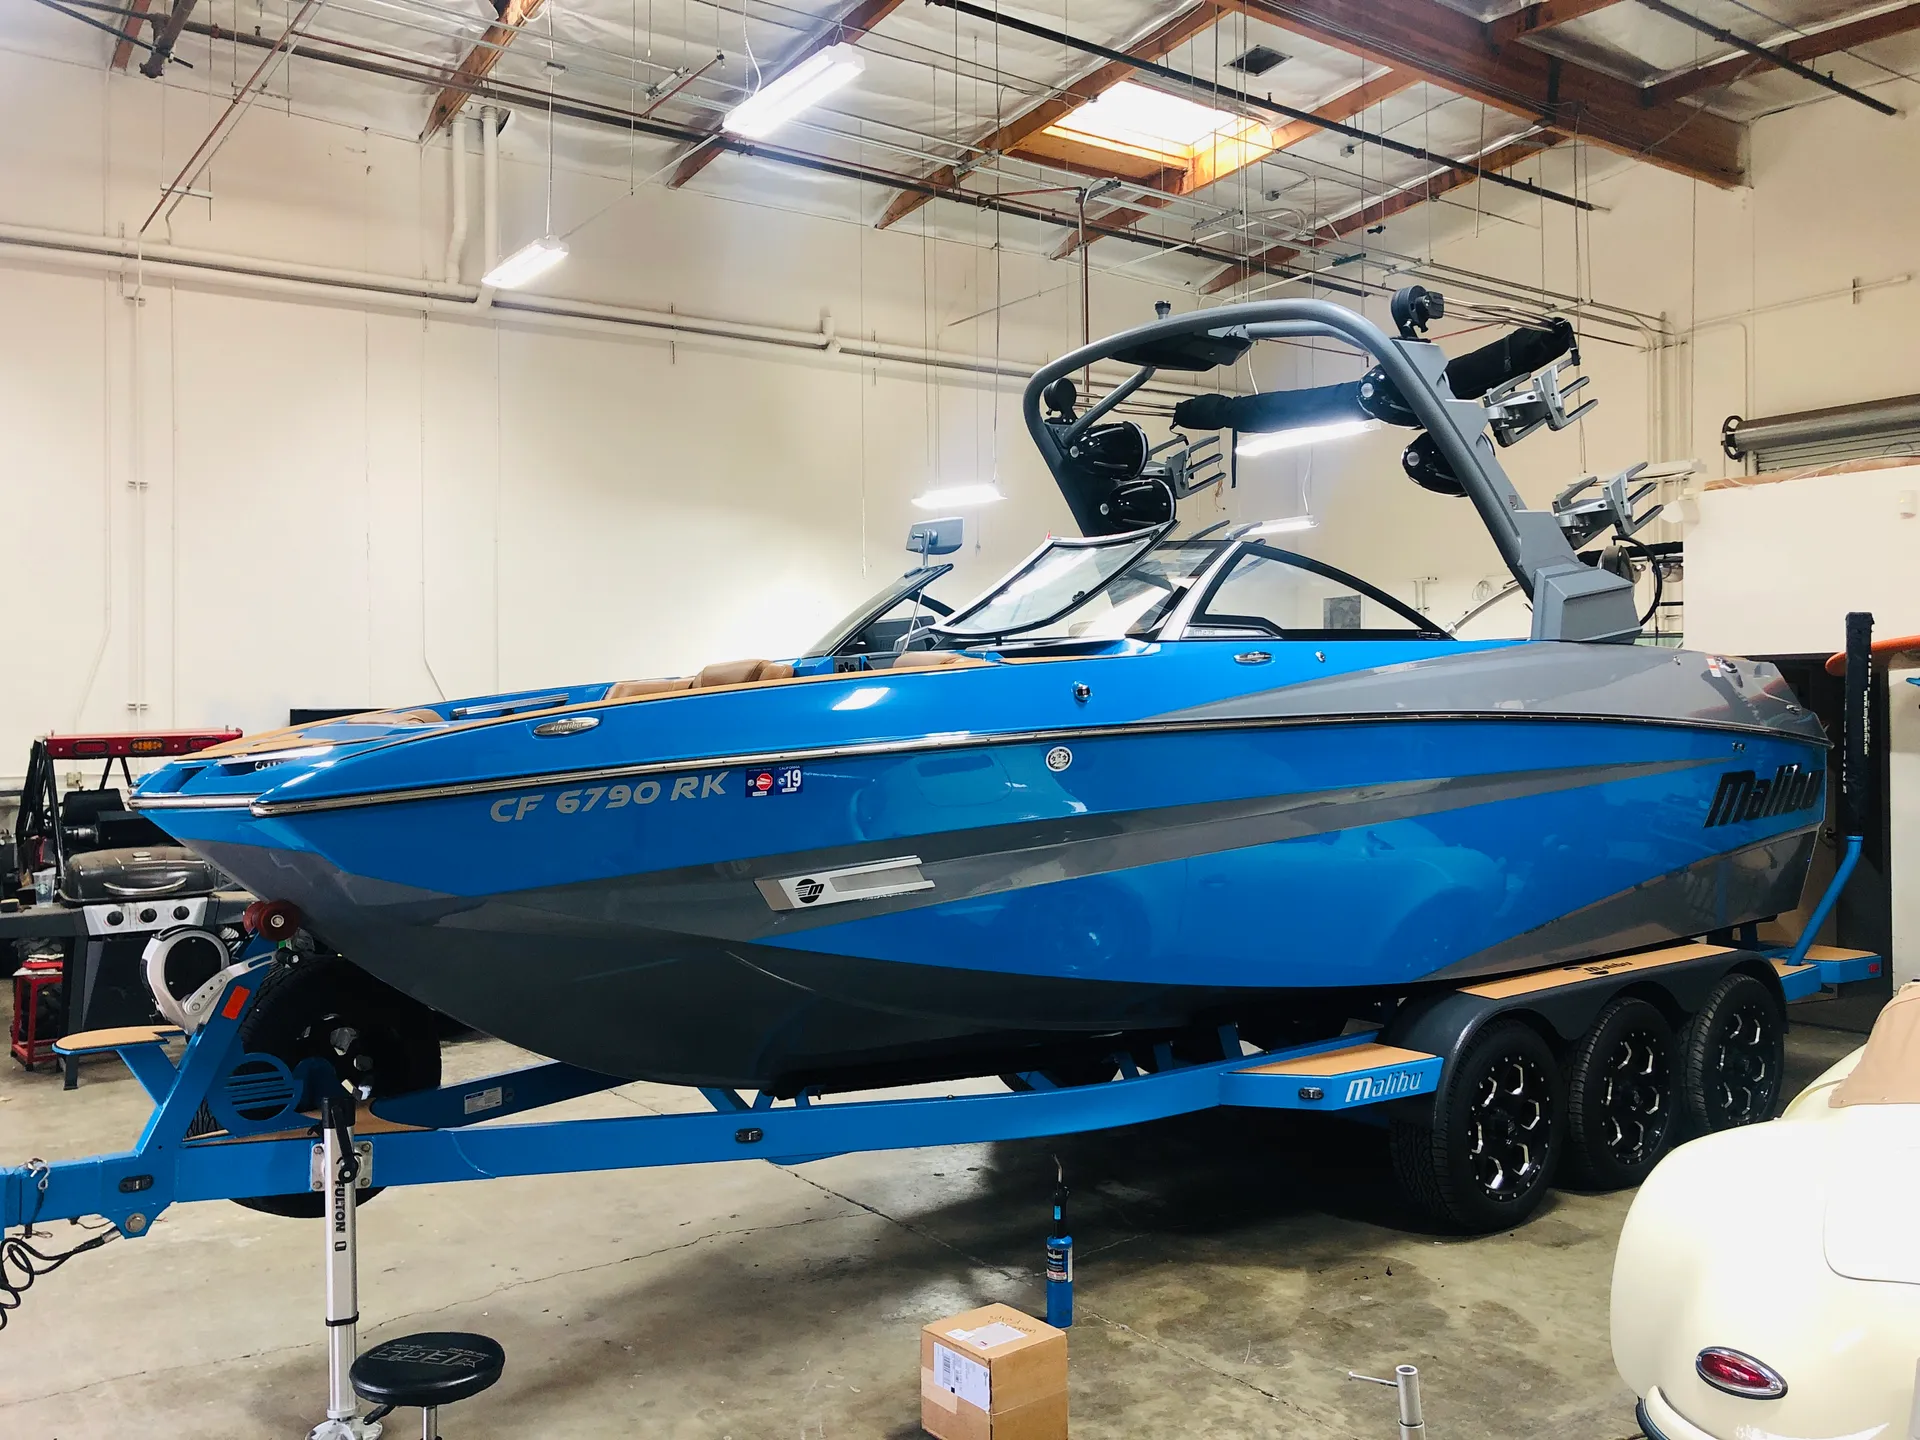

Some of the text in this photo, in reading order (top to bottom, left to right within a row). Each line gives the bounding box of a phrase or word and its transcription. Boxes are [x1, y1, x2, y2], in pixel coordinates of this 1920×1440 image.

[490, 771, 730, 822] CF 6790 RK
[784, 769, 802, 788] 19
[1703, 762, 1825, 828] Malibu
[1345, 1071, 1422, 1103] Malibu
[334, 1181, 346, 1233] FULTON
